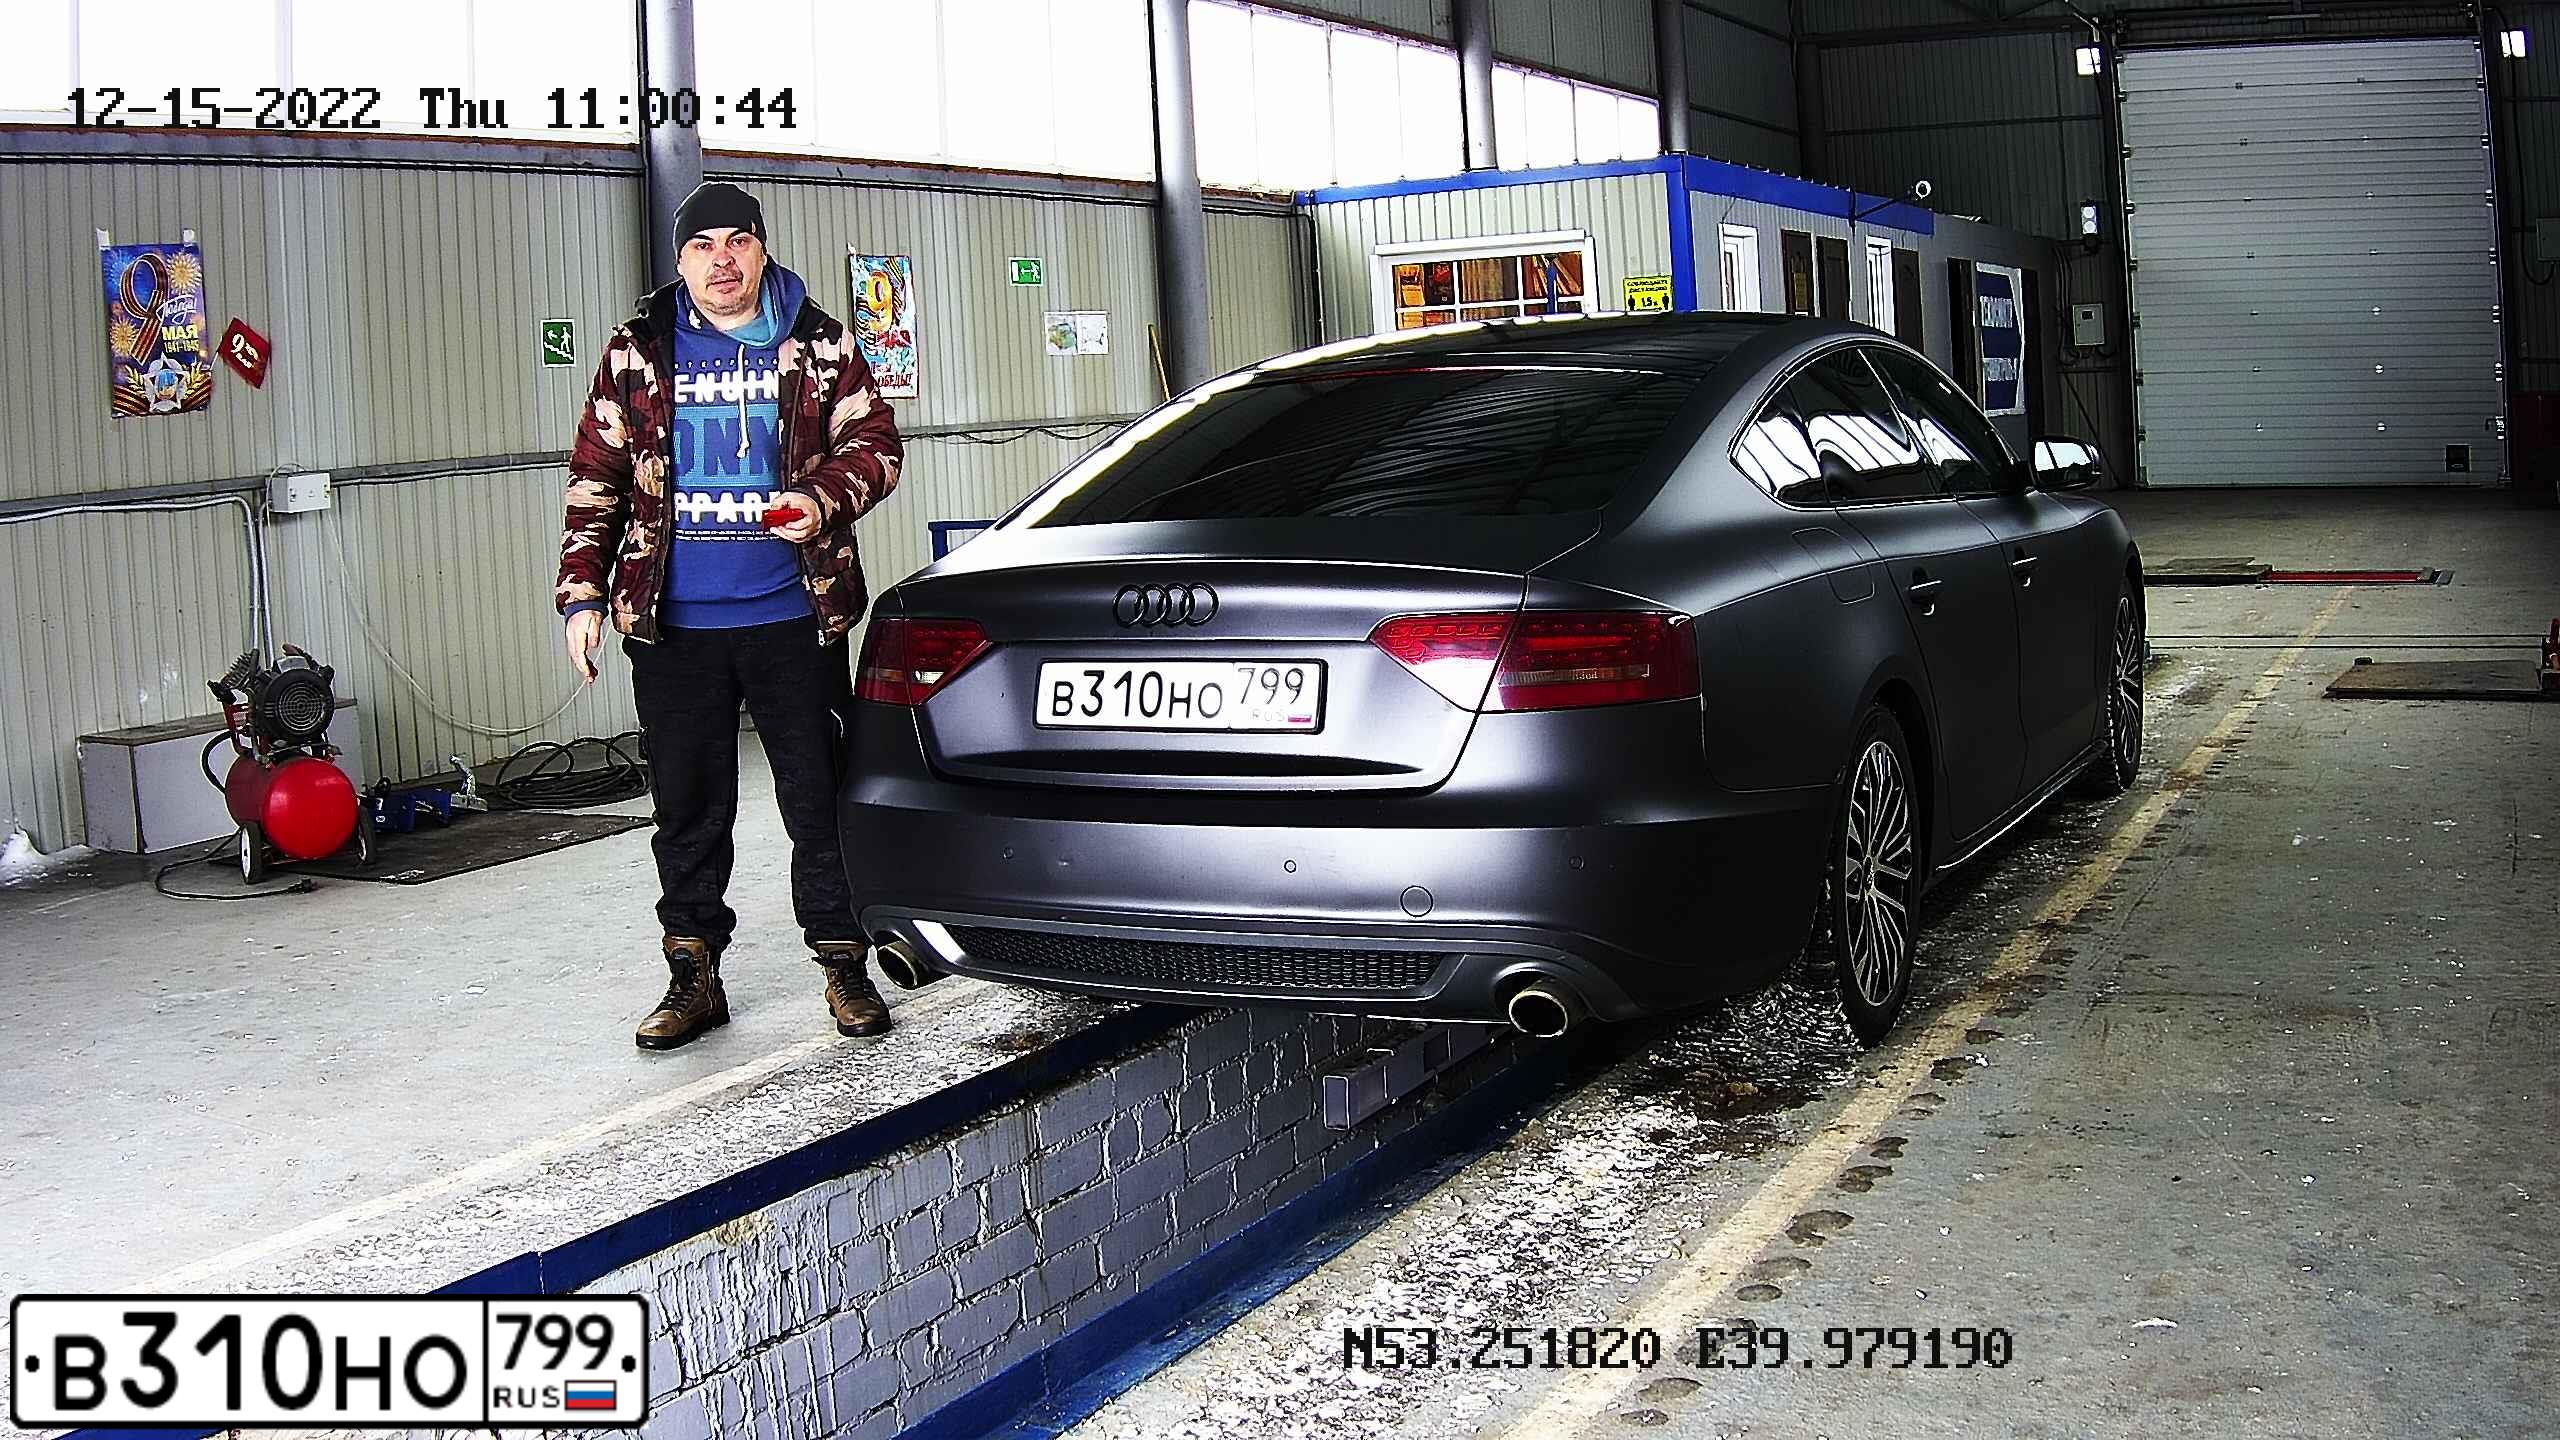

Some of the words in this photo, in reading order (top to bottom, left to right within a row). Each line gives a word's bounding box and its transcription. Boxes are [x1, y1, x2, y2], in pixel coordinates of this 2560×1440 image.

[162, 324, 199, 341] МАЯ
[674, 369, 779, 403] ENUIN
[1237, 667, 1304, 705] 799
